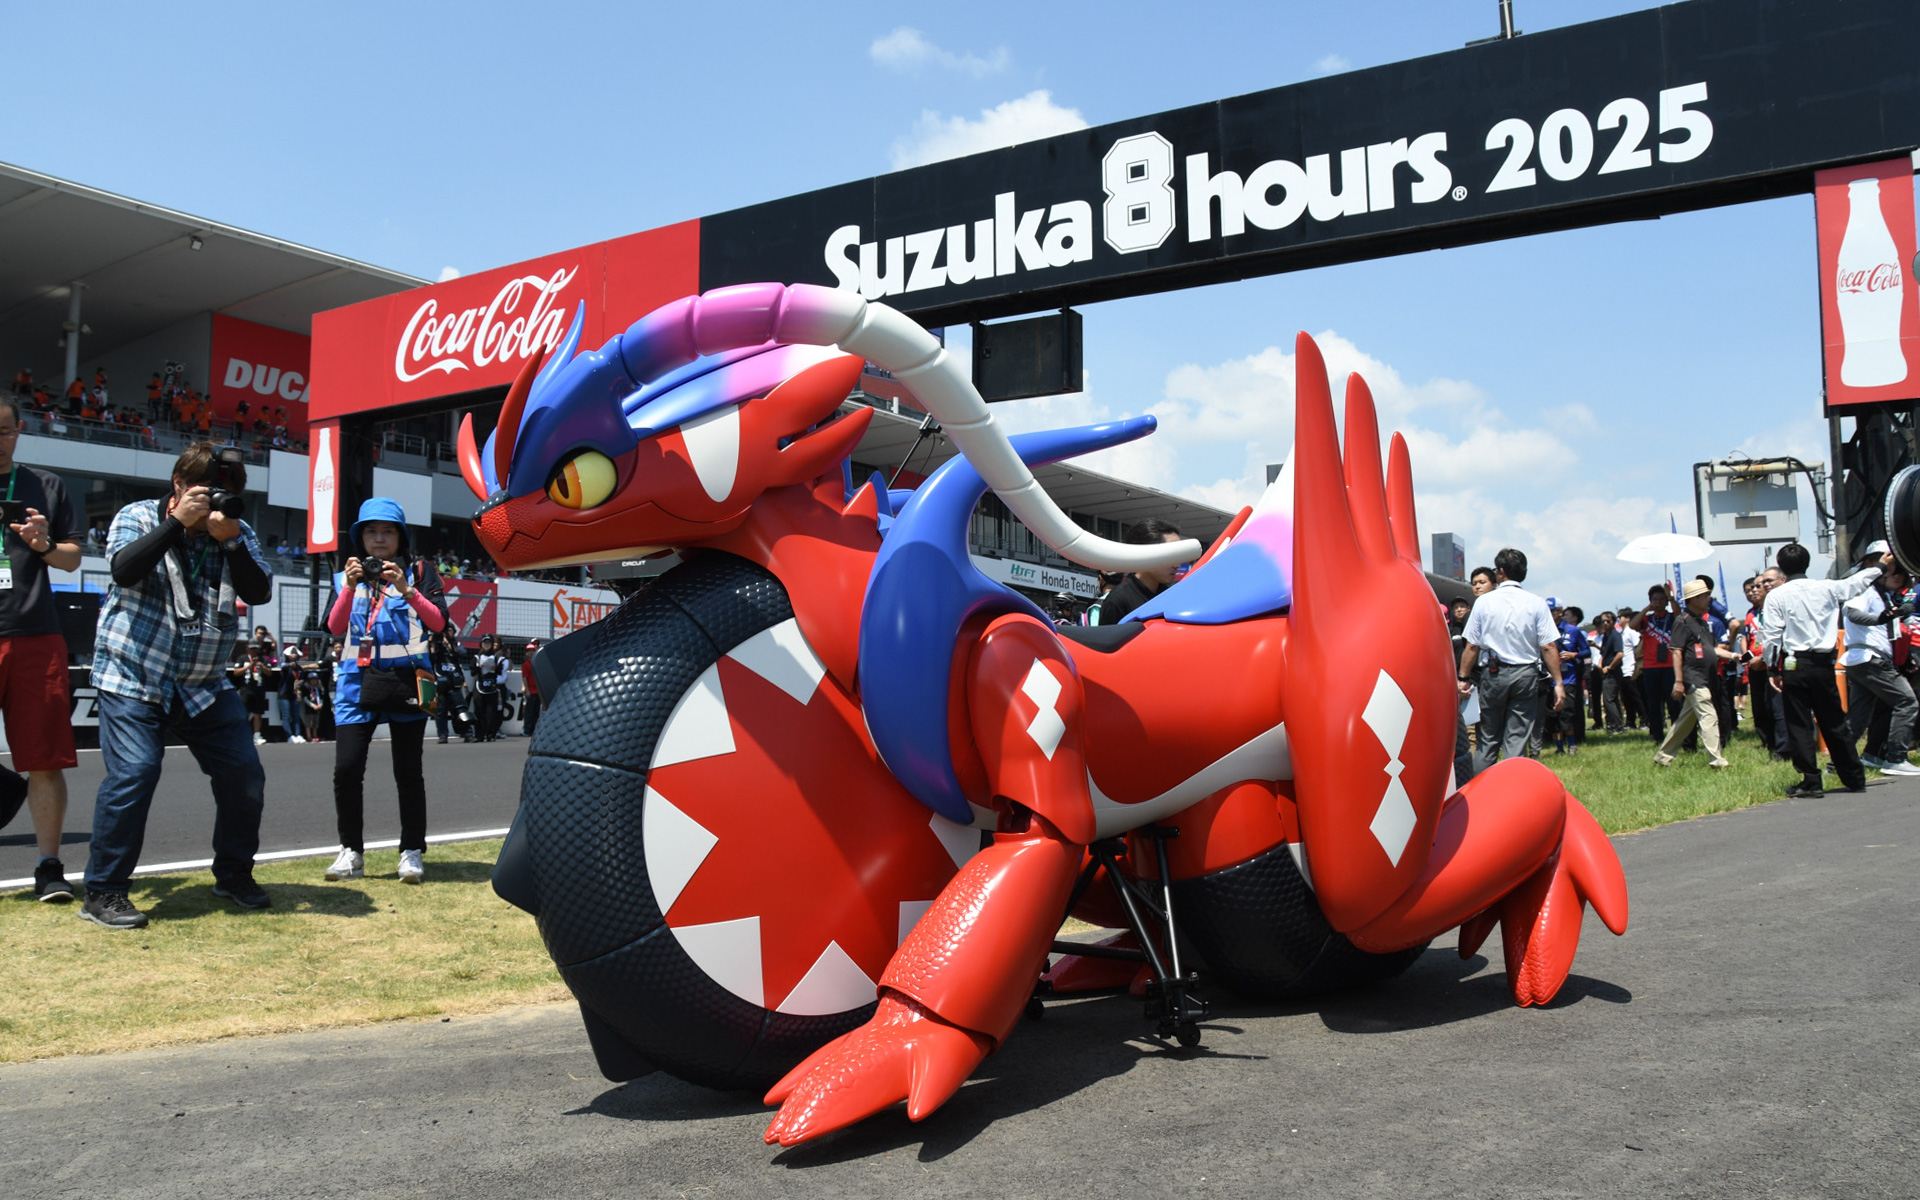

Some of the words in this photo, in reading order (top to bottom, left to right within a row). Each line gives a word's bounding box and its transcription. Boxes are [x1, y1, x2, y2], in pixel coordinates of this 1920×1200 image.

[824, 192, 1093, 300] Suzuka
[1102, 131, 1176, 255] 8
[1485, 81, 1714, 193] 2025
[1838, 262, 1902, 294] Coca-Cola
[395, 264, 579, 382] Coca-Cola
[1041, 570, 1070, 589] Honda
